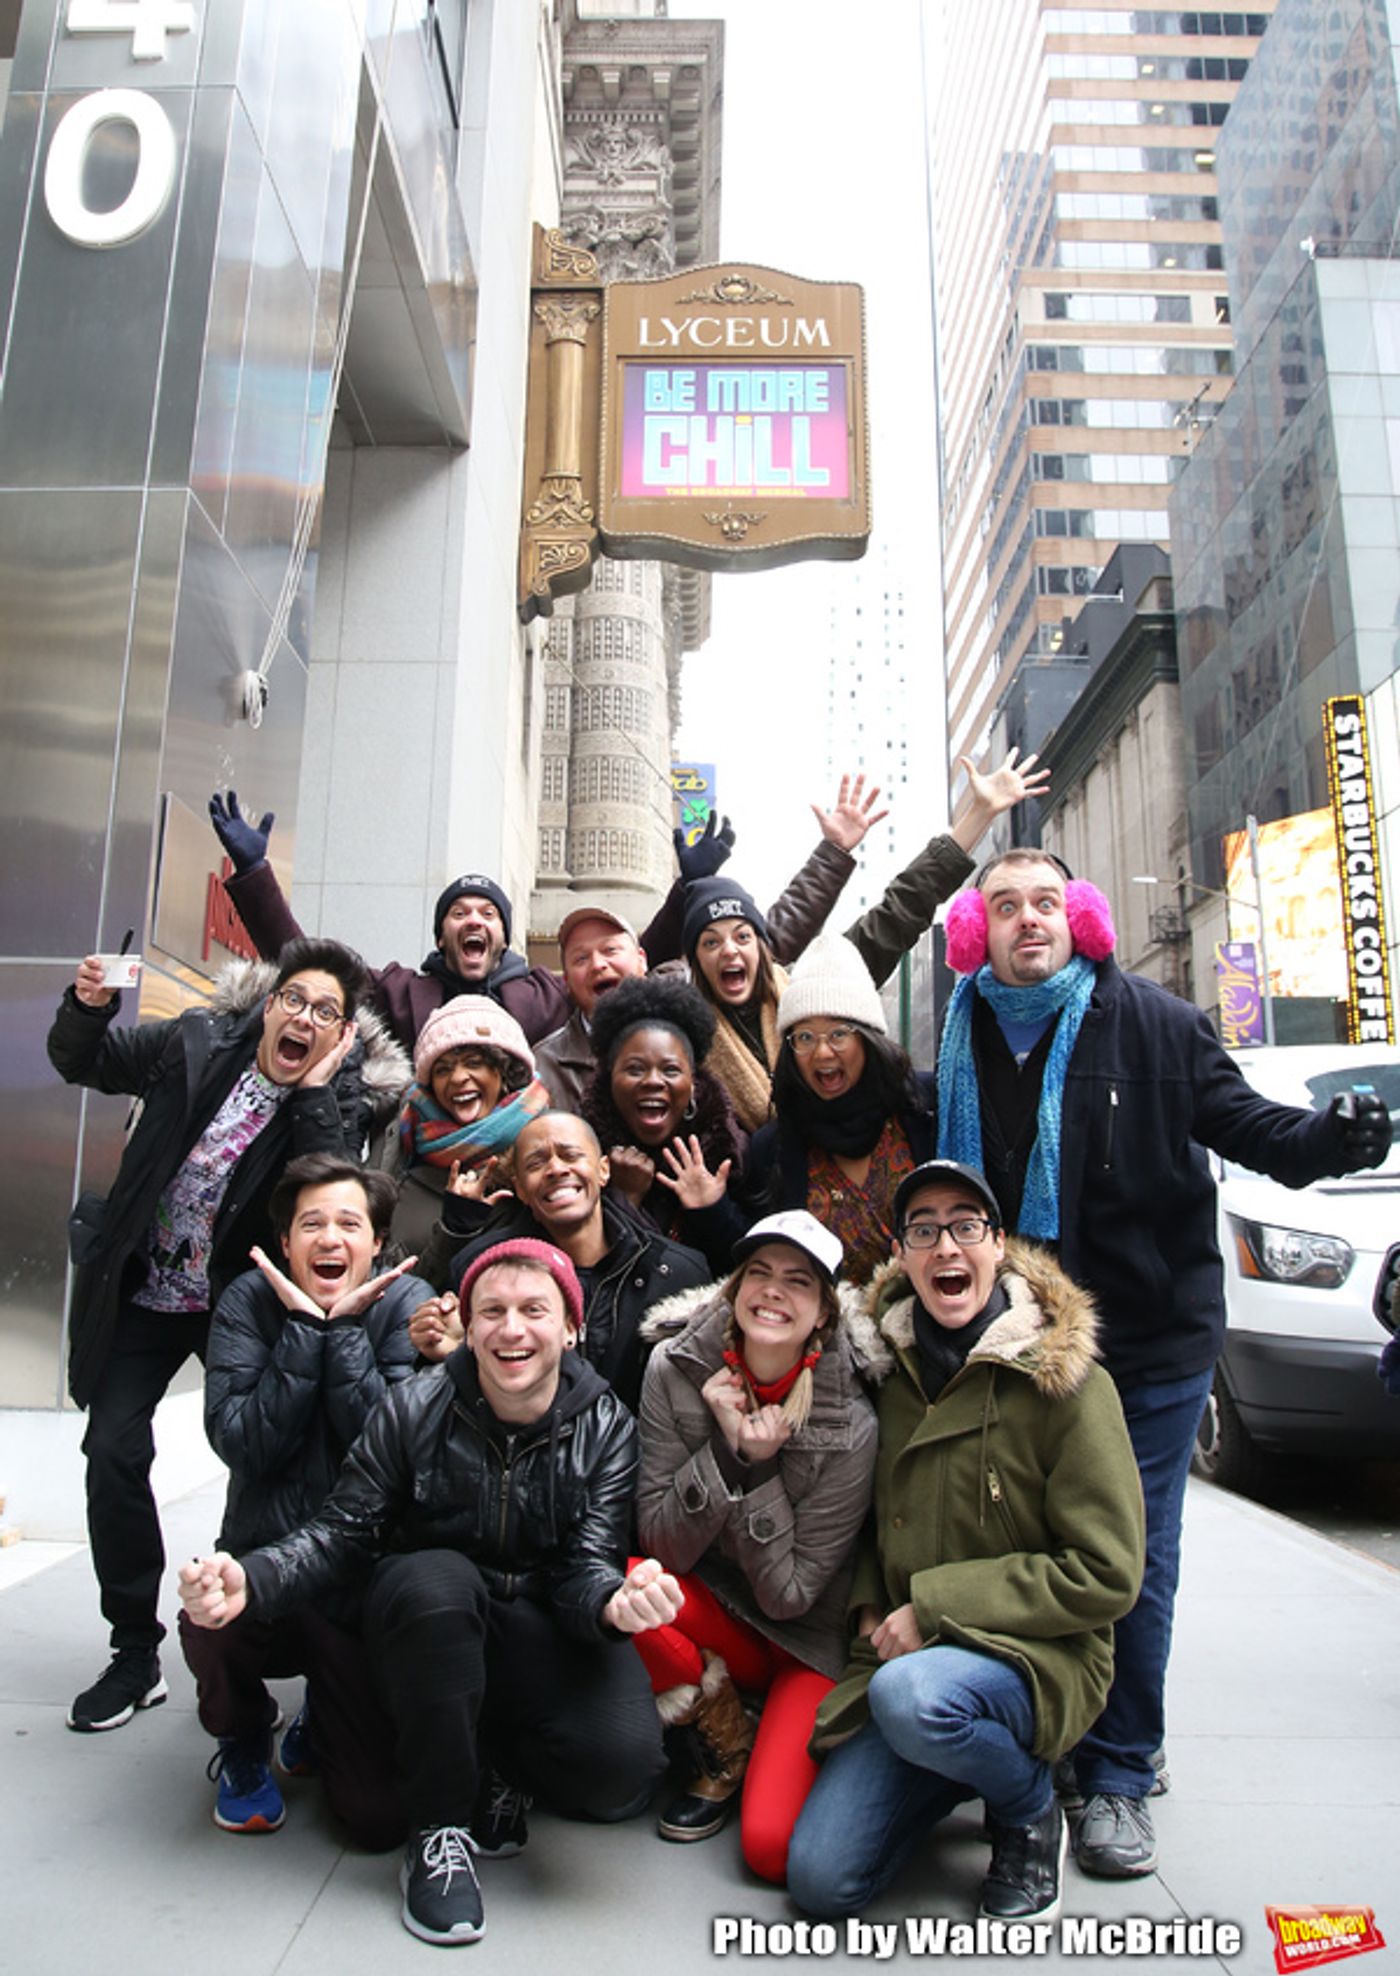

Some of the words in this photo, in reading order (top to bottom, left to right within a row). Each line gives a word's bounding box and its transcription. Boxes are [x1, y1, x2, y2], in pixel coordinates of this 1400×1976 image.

[639, 317, 832, 348] LYCEUM
[644, 370, 697, 412] BE
[707, 370, 830, 412] MORE
[1334, 713, 1378, 920] STARBUCKS
[1353, 926, 1388, 1040] COFFEE
